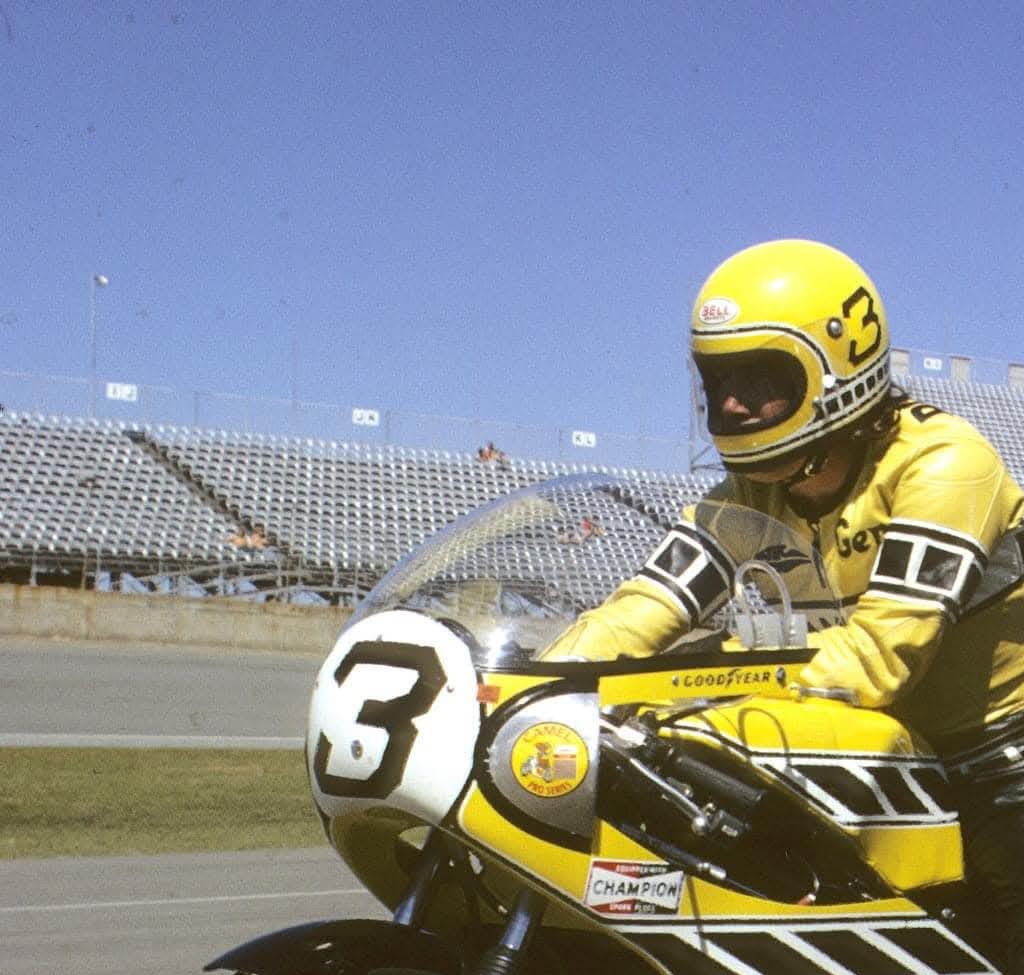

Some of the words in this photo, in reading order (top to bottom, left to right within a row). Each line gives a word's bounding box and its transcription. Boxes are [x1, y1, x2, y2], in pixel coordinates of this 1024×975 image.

[701, 303, 729, 317] BELL
[841, 285, 882, 368] 3
[682, 667, 771, 689] GOODYEAR
[313, 640, 449, 800] 3
[593, 879, 678, 898] CHAMPION
